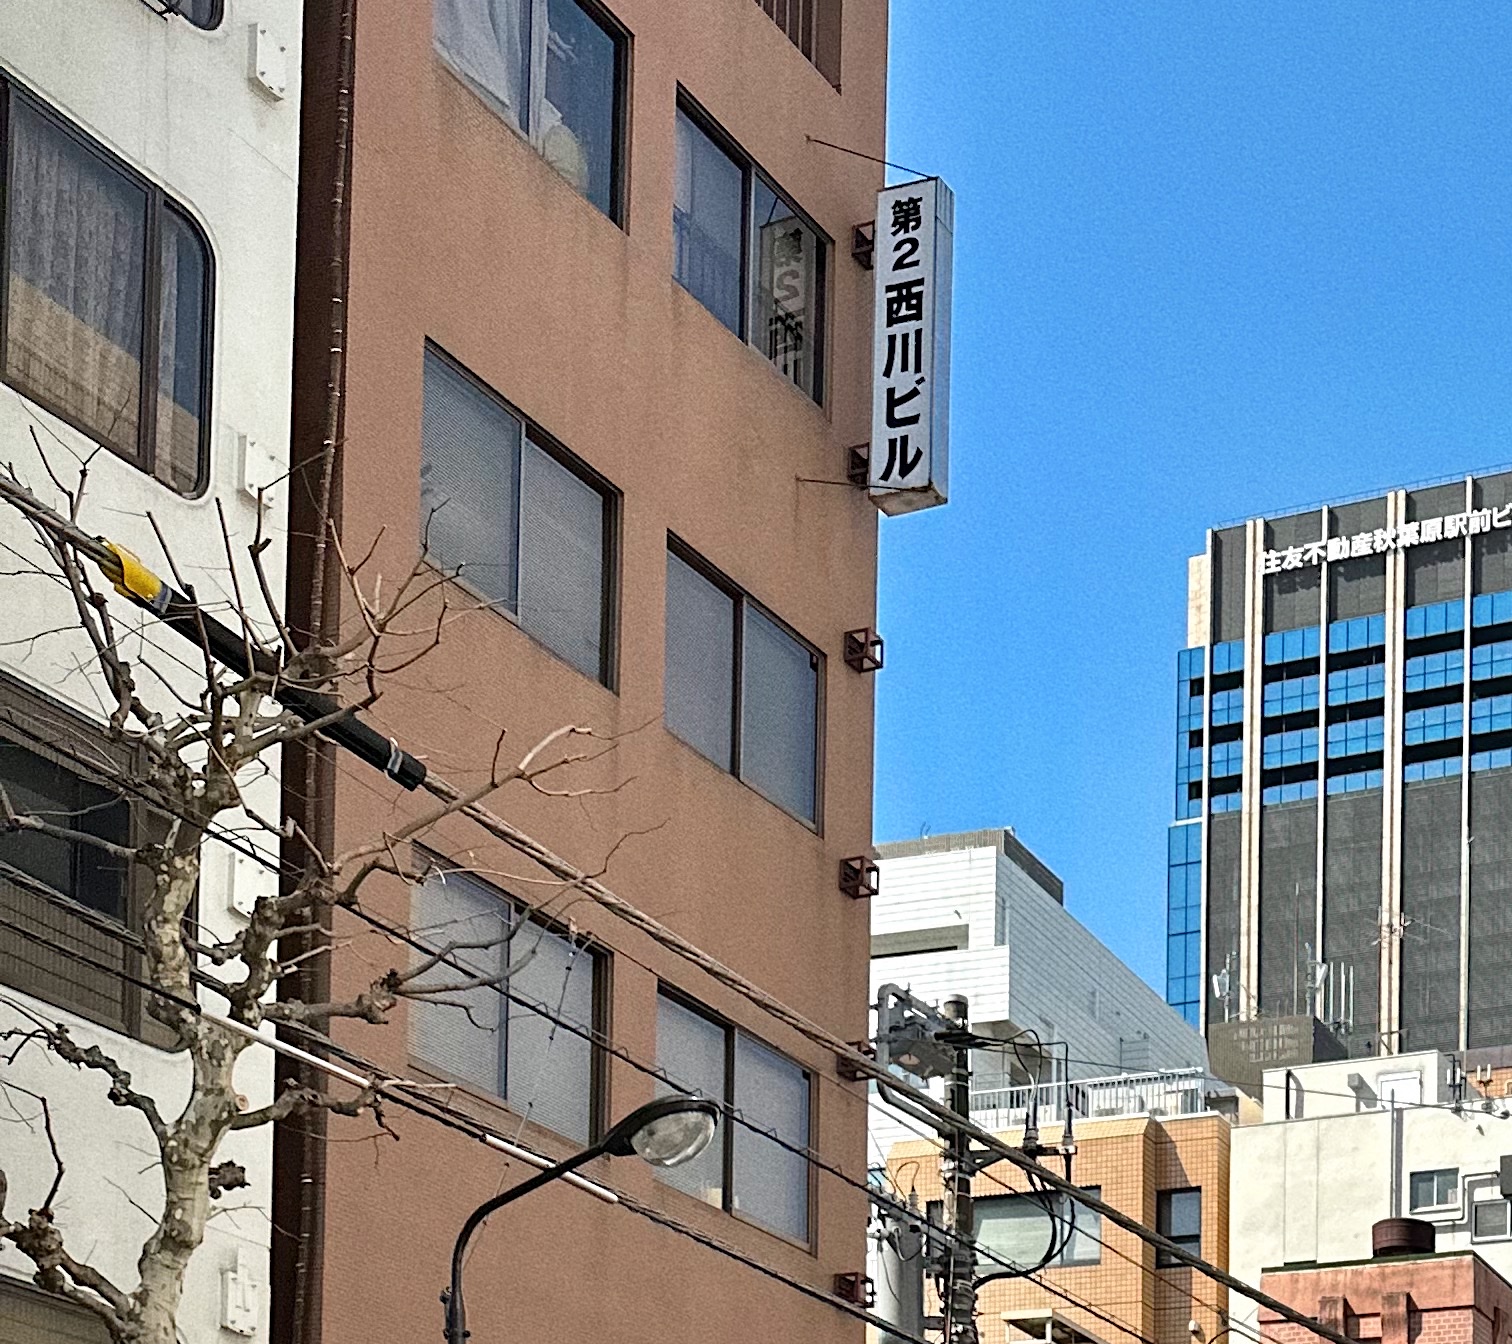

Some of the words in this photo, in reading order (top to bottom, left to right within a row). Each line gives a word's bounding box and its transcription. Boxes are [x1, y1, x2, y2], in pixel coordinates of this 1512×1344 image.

[879, 196, 925, 481] 第2西川ビル
